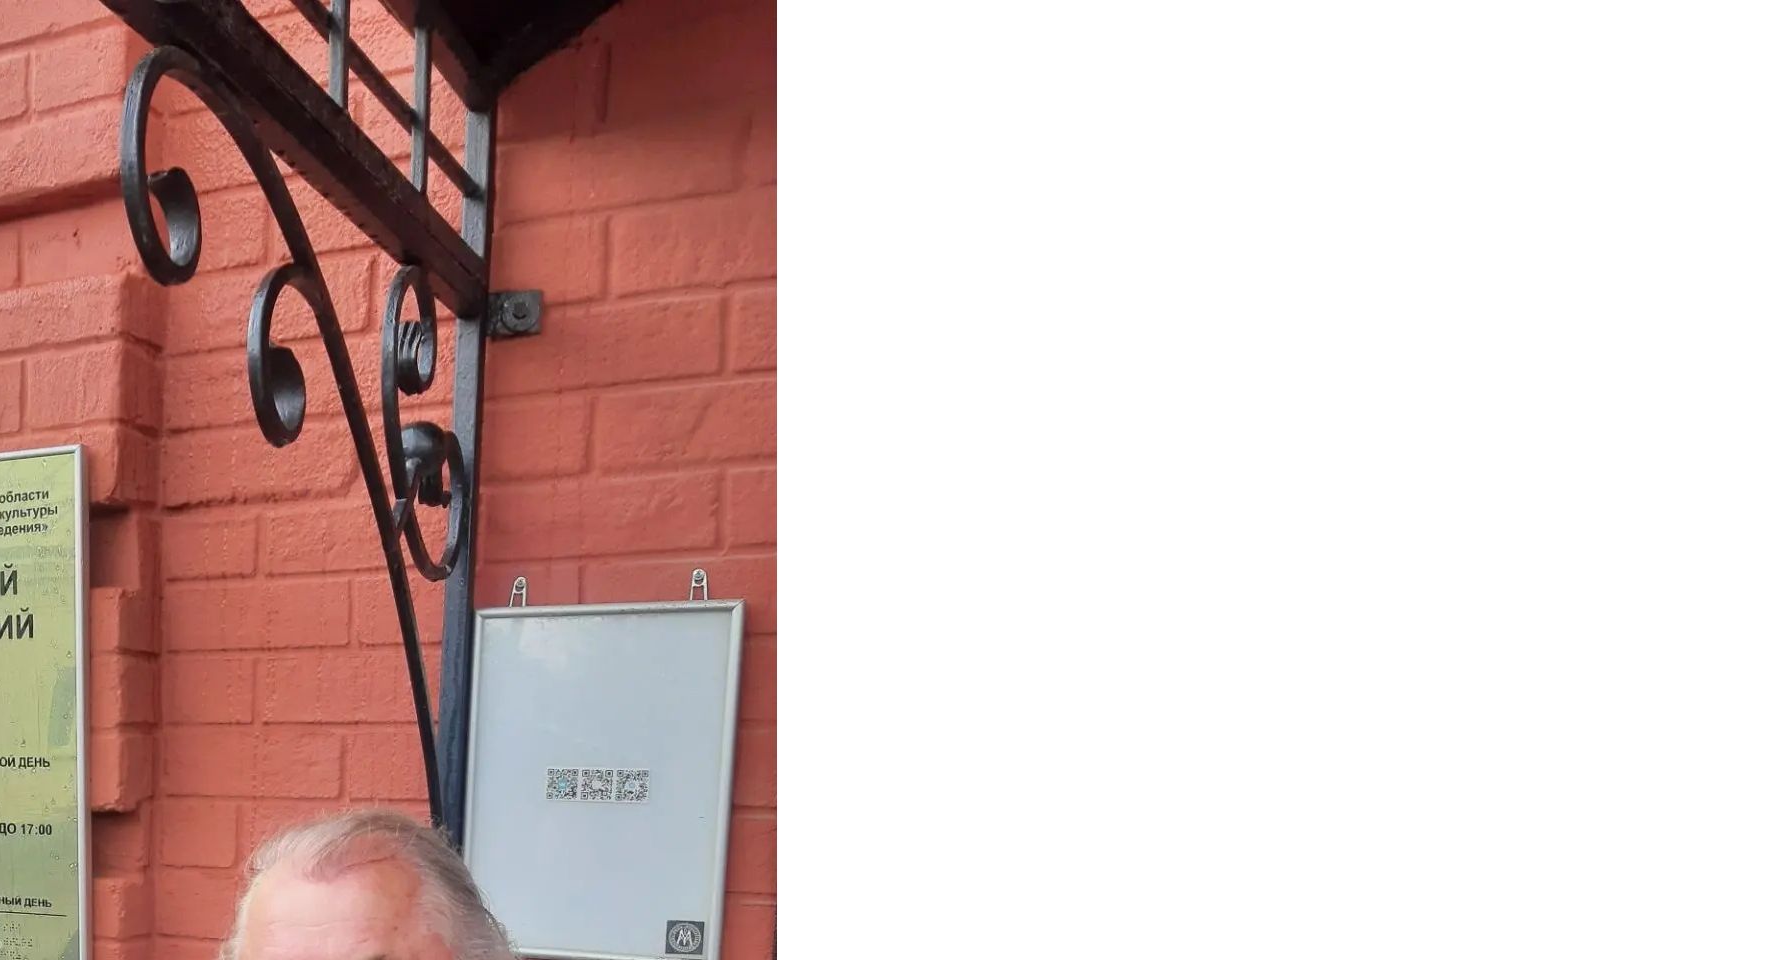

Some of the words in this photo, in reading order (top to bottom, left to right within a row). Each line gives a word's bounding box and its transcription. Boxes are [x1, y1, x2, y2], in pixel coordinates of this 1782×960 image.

[0, 505, 58, 522] культуры
[18, 756, 50, 769] ДЕНЬ
[20, 824, 52, 836] 17:00
[24, 898, 52, 908] ДЕНЬ
